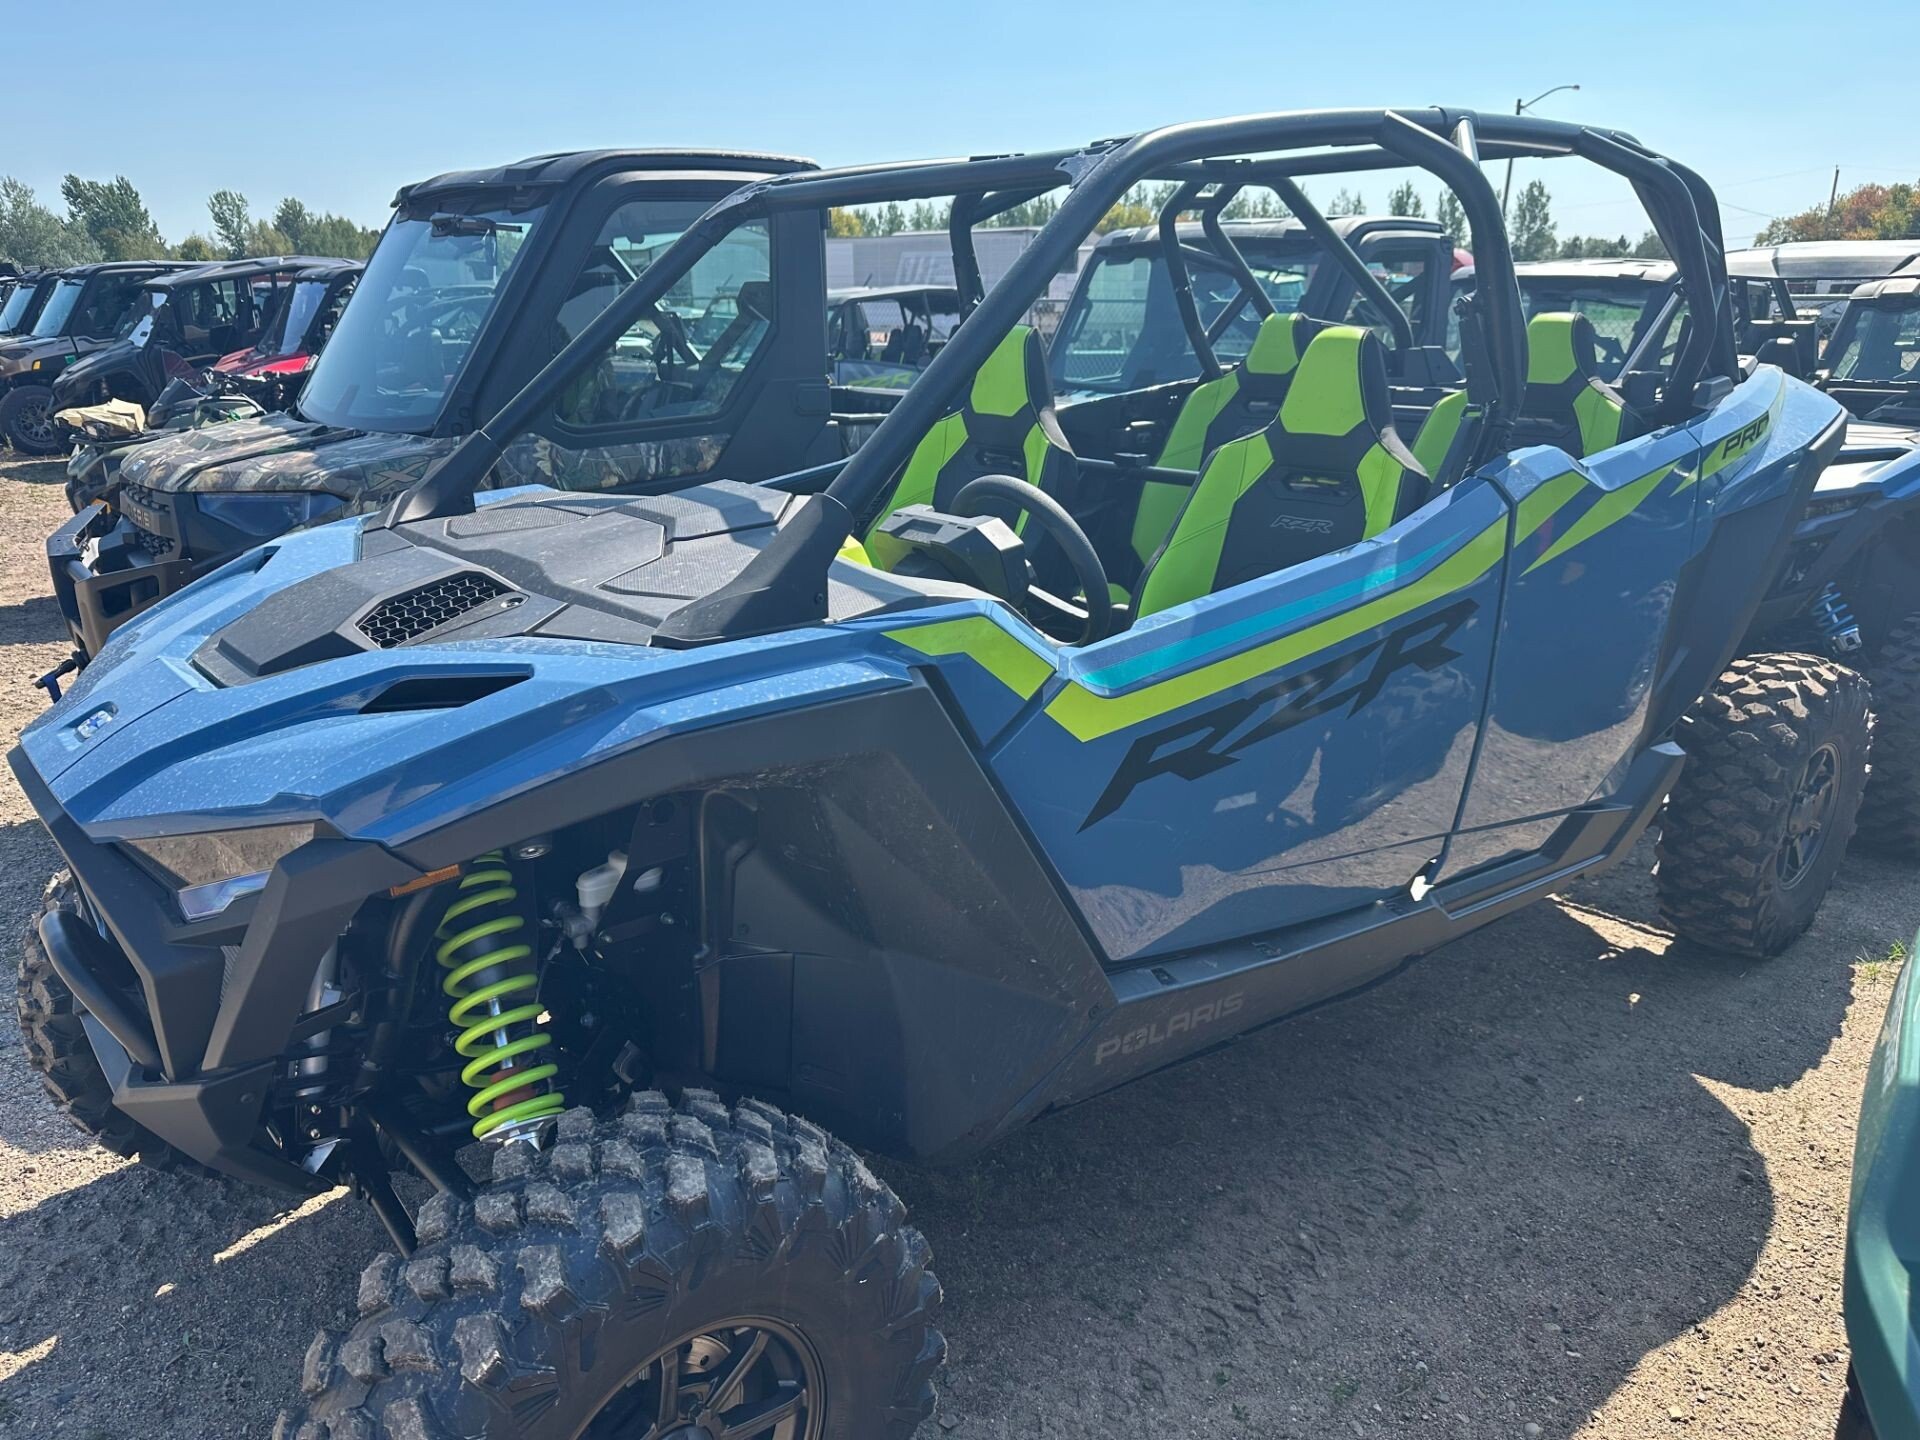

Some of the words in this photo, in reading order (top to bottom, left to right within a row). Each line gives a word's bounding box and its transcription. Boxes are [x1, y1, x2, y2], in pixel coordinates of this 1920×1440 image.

[1721, 411, 1770, 460] PRO
[1270, 514, 1334, 534] RZR
[1076, 598, 1480, 835] RZR
[1094, 991, 1244, 1066] POLARIS
